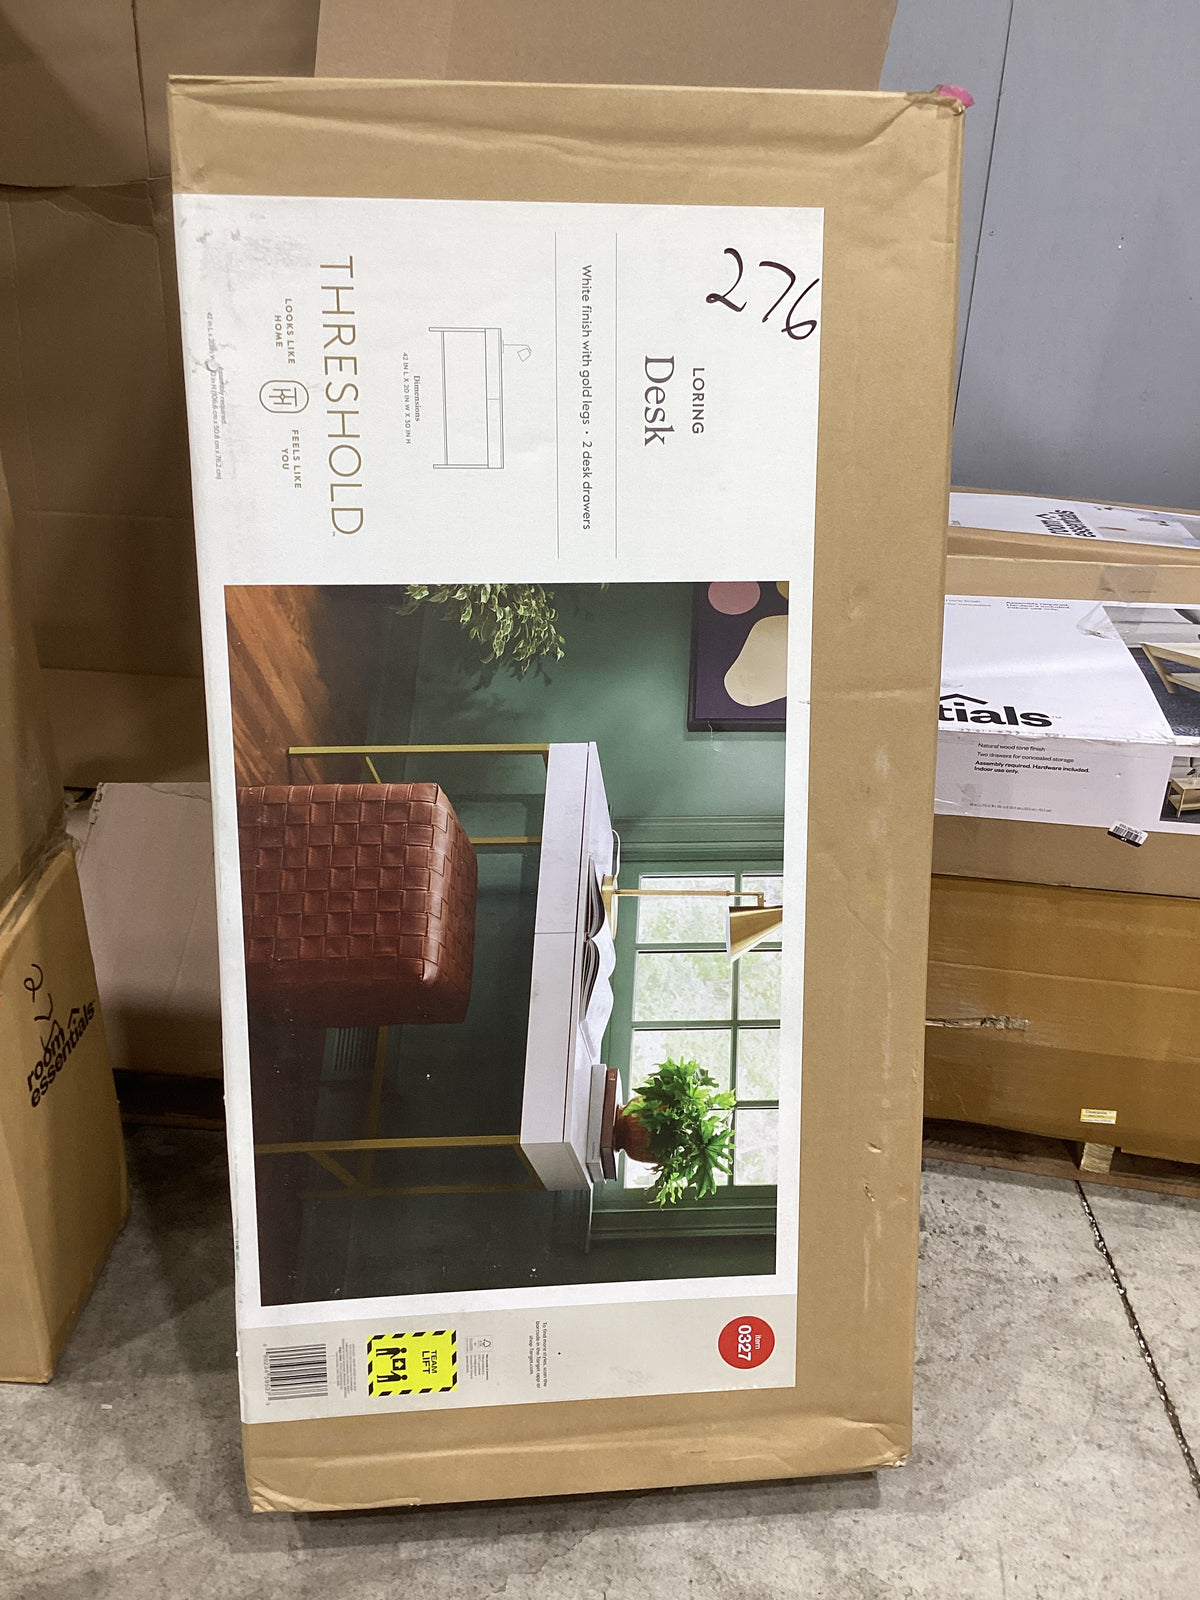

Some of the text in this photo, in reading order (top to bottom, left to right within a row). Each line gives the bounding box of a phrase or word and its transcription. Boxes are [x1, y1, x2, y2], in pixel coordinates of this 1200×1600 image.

[582, 264, 592, 302] White
[706, 247, 819, 340] 276
[275, 315, 283, 348] HOME
[285, 298, 296, 365] LOOKS LIKE
[582, 305, 592, 338] finish
[403, 352, 408, 361] 42
[403, 362, 408, 370] IN
[582, 340, 592, 367] with
[319, 256, 364, 534] THRESHOLD
[404, 385, 409, 393] 20
[413, 375, 421, 422] Dimensions
[579, 370, 592, 398] gold
[692, 367, 705, 434] LORING
[580, 400, 592, 425] legs
[644, 355, 675, 447] Desk
[281, 448, 289, 471] YOU
[292, 429, 302, 489] FEELS LIKE
[583, 451, 592, 479] desk
[583, 481, 592, 530] drawers
[975, 760, 1004, 768] Assembly
[27, 1027, 66, 1092] room
[31, 1001, 95, 1108] essentials
[738, 1324, 752, 1361] 0327
[754, 1334, 762, 1350] item
[422, 1350, 430, 1374] LIFT
